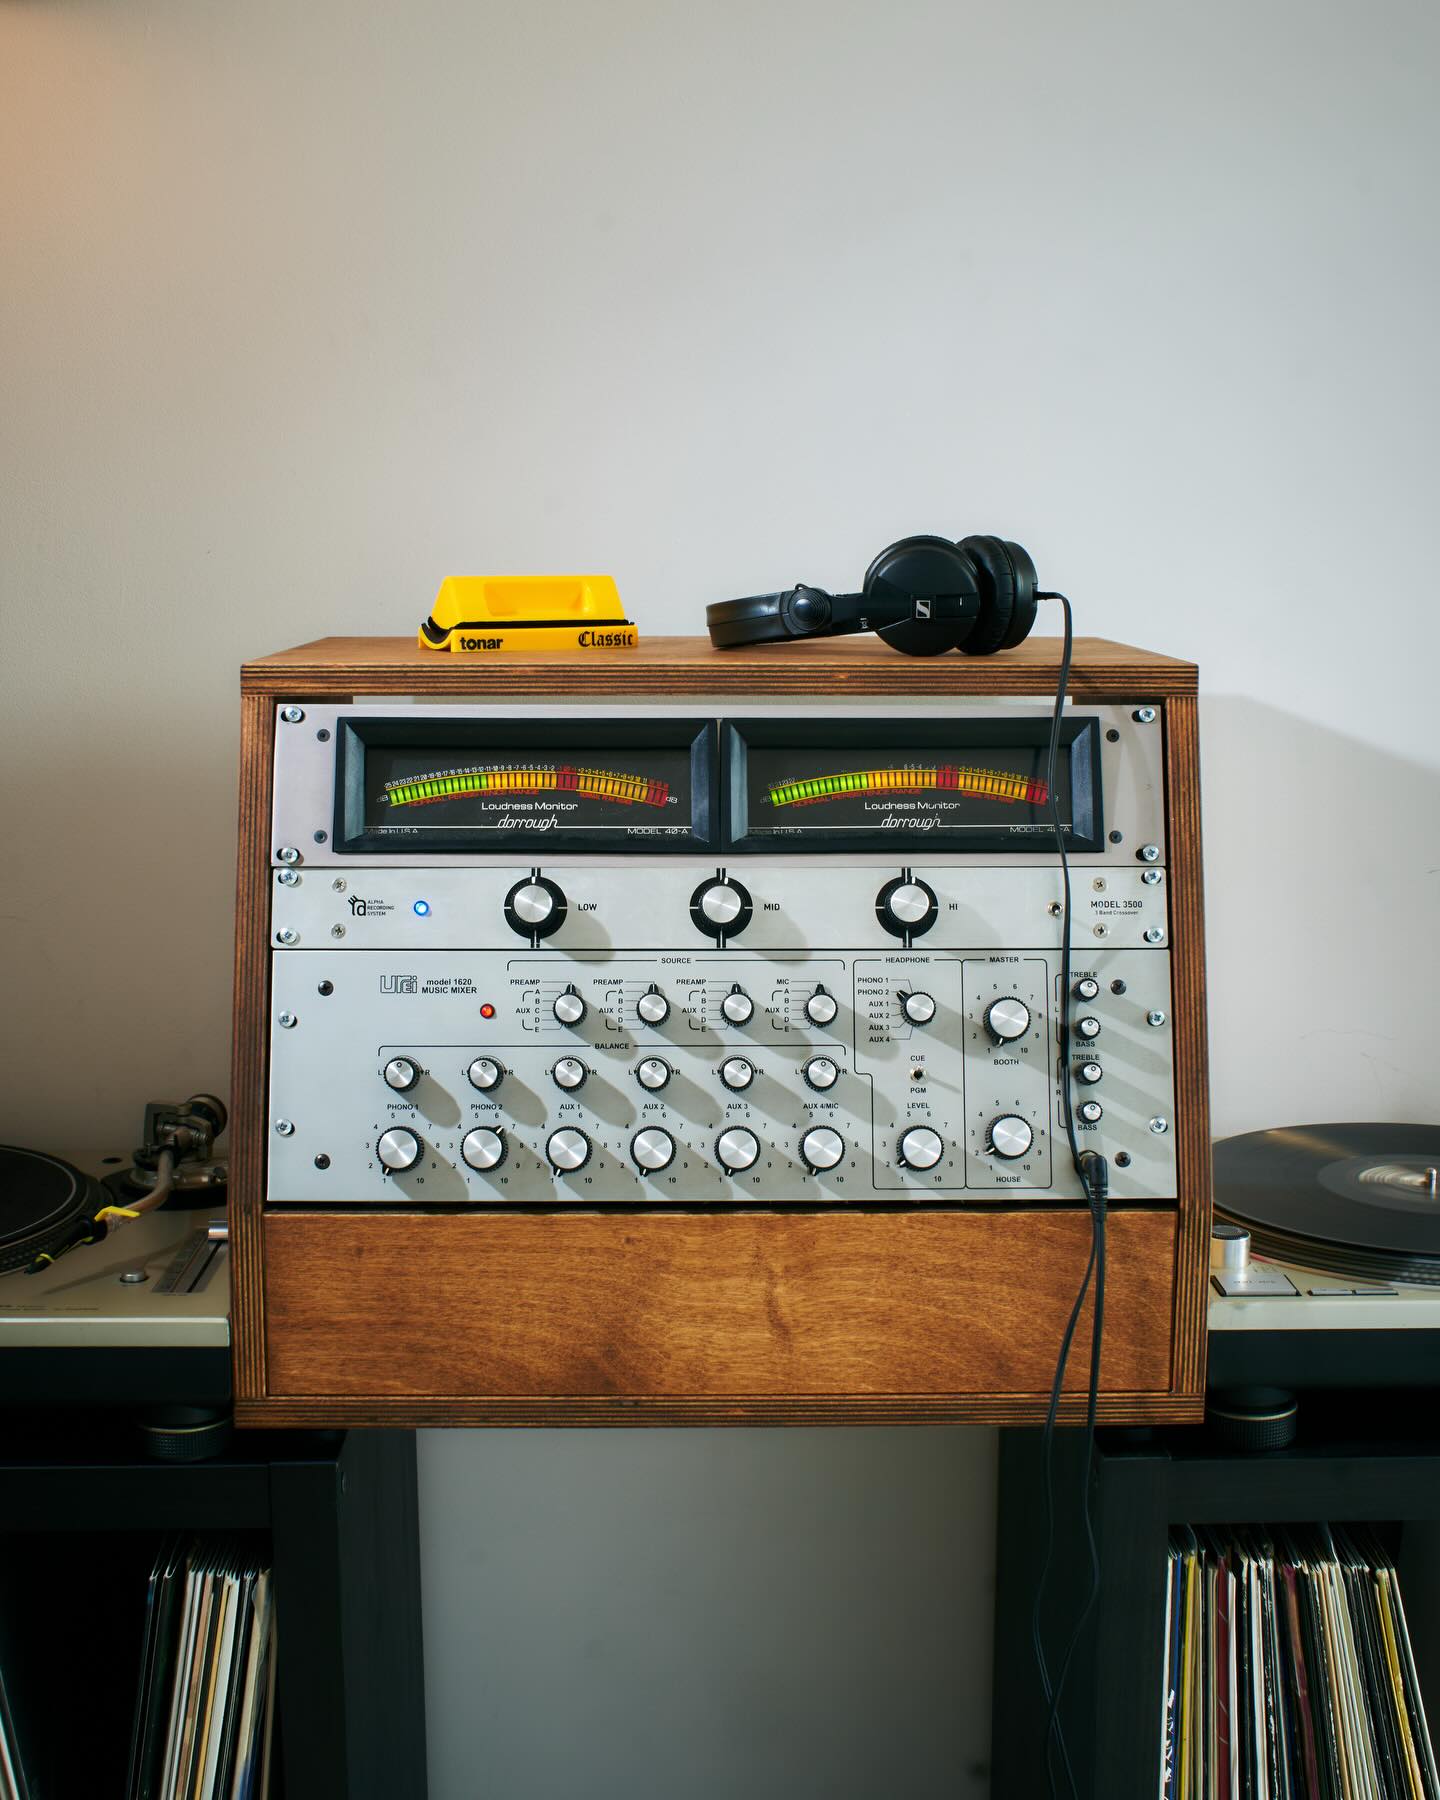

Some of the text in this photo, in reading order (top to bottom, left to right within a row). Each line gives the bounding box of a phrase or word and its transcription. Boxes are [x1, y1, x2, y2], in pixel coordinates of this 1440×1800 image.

[459, 636, 504, 650] tonar
[578, 631, 633, 647] Classic
[481, 802, 578, 810] Loudness Monitor
[864, 802, 915, 810] Loudness
[497, 814, 558, 831] dorrough
